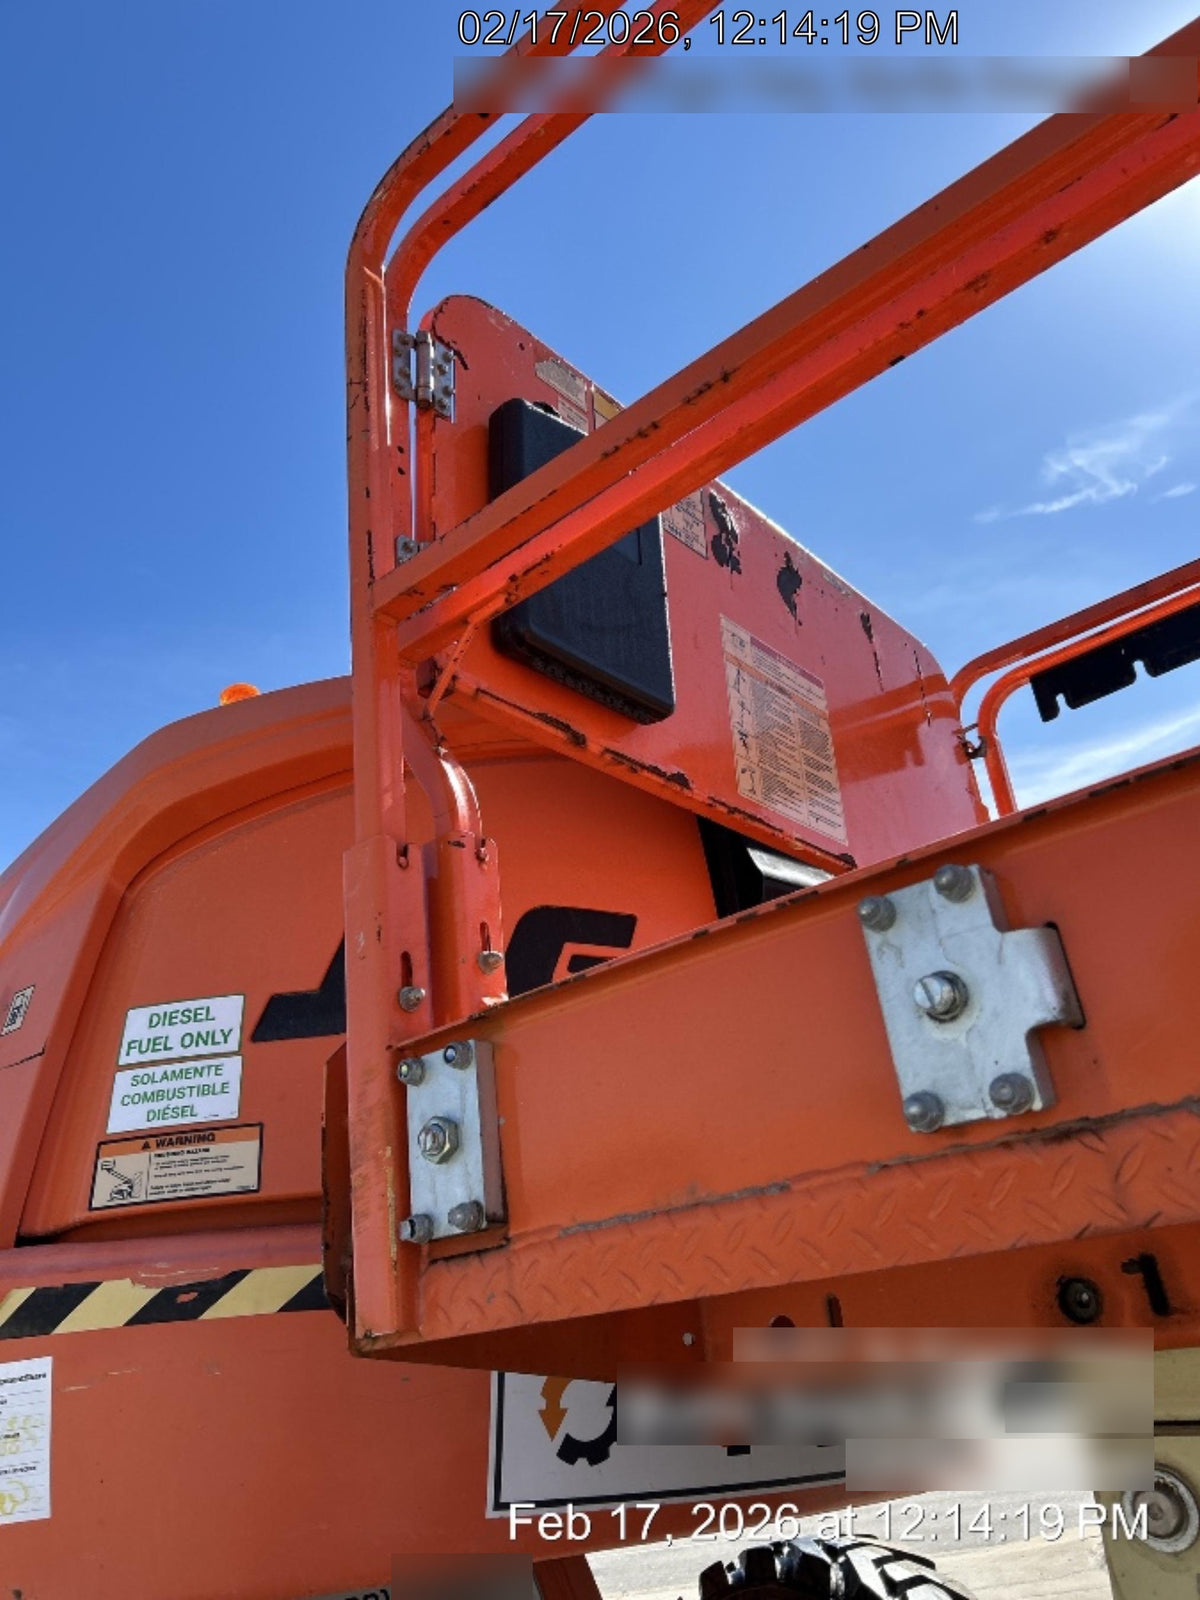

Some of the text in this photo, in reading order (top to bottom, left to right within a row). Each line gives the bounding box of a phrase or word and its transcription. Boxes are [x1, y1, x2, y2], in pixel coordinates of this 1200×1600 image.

[148, 1006, 216, 1029] DIESEL
[125, 1028, 233, 1056] FUEL ONLY
[130, 1063, 225, 1087] SOLAMENTE
[120, 1082, 230, 1107] COMBUSTIBLE
[146, 1103, 198, 1123] DIÉSEL
[155, 1132, 216, 1149] WARNING
